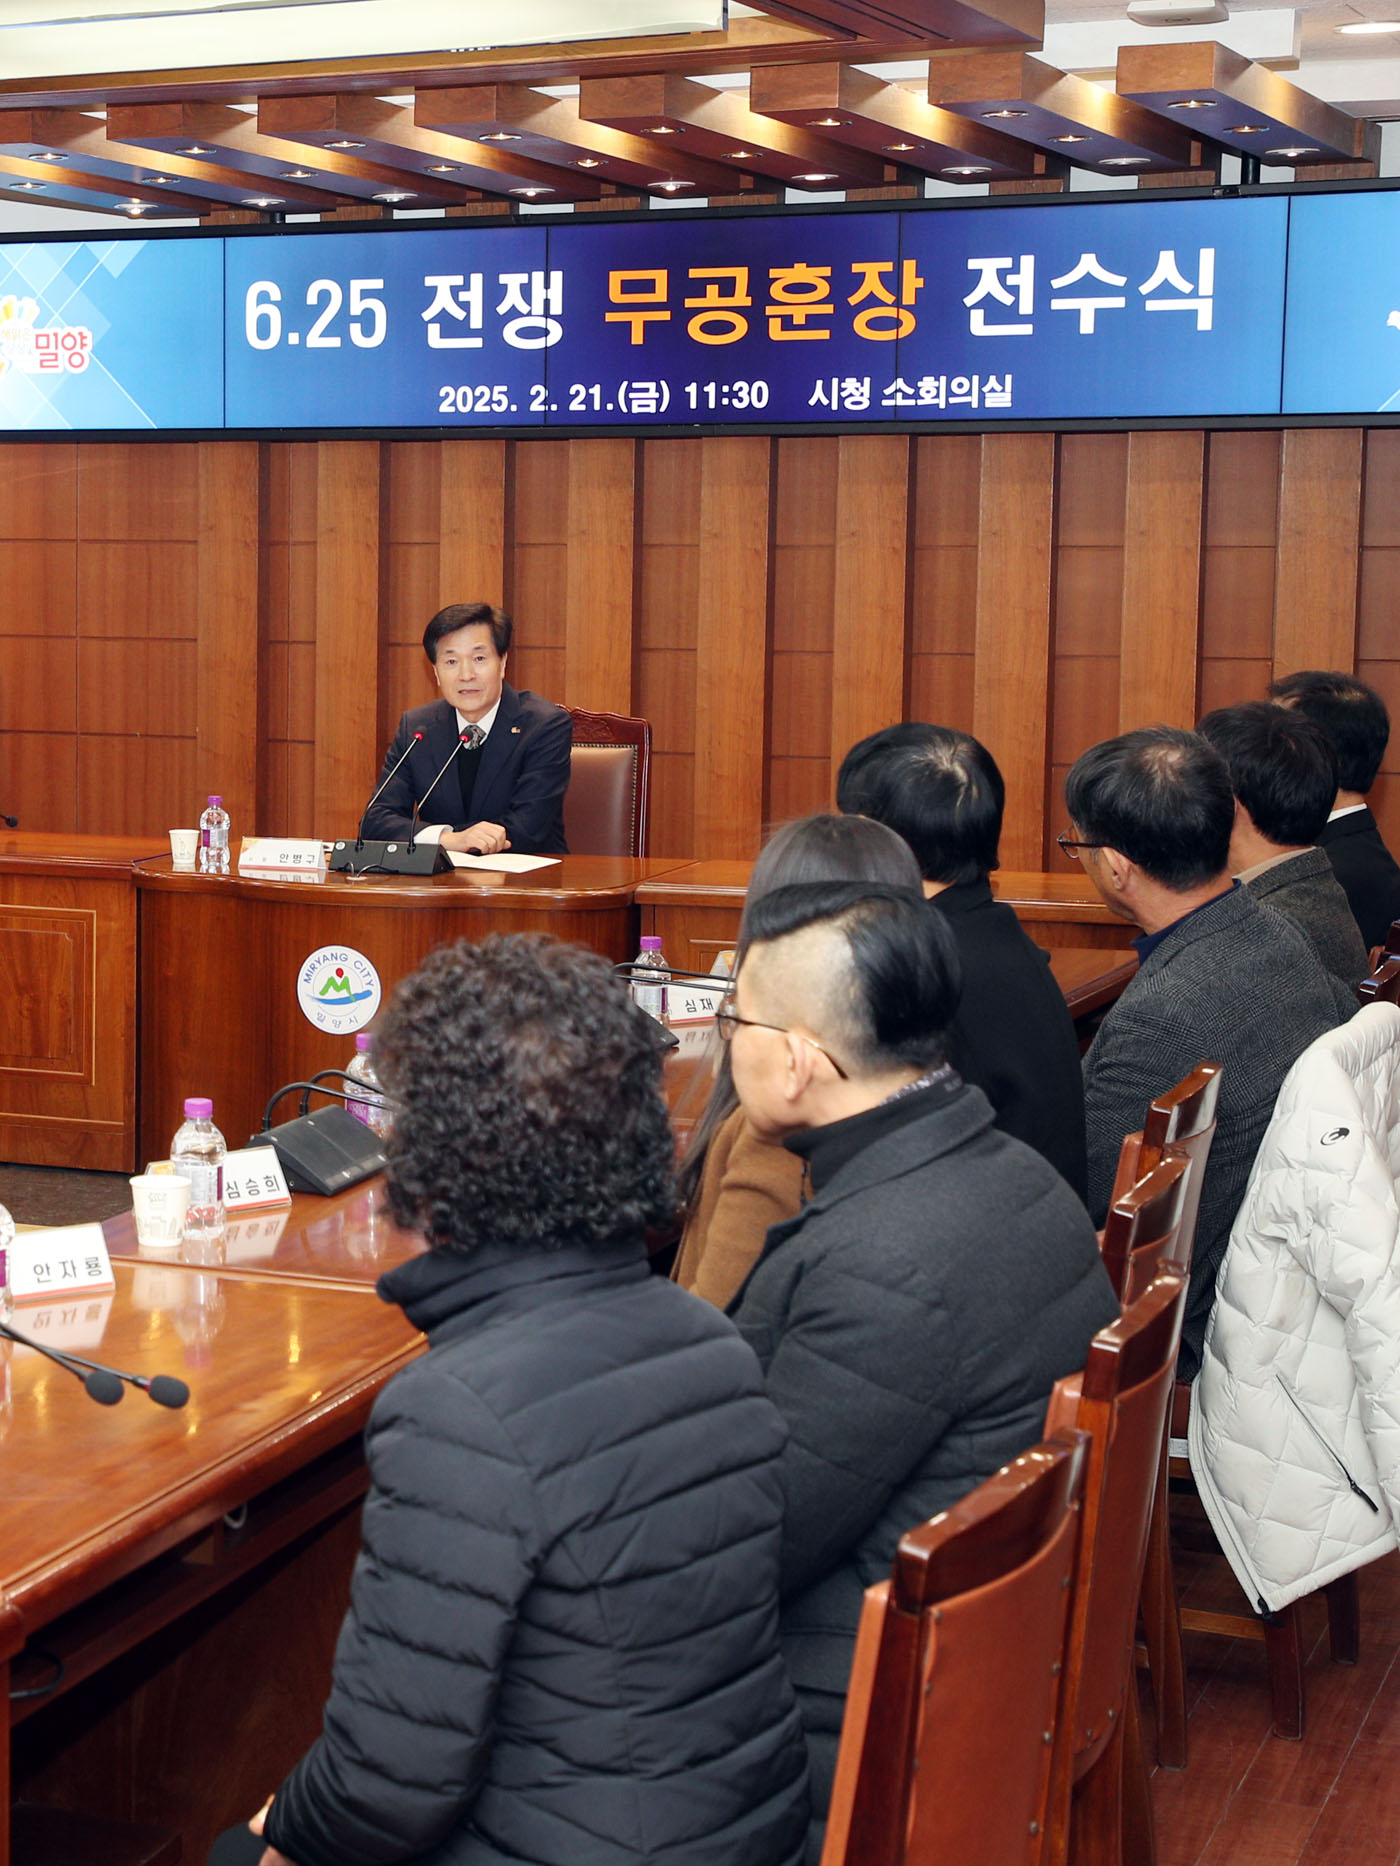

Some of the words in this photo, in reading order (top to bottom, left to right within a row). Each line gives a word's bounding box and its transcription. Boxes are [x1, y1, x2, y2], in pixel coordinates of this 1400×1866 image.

[245, 278, 387, 350] 6.25
[421, 270, 564, 350] 전쟁
[604, 259, 925, 345] 무공훈장
[962, 247, 1215, 337] 전수식
[34, 331, 88, 368] 밀양
[438, 385, 518, 413] 2025.
[529, 384, 558, 412] 2.
[568, 380, 671, 414] 21.(금)
[684, 380, 769, 410] 11:30
[808, 376, 872, 411] 시청
[881, 374, 1013, 410] 소회의실
[303, 952, 349, 984] MIRYANG
[353, 960, 375, 987] CITY
[225, 1174, 281, 1200] 심승희
[33, 1256, 103, 1284] 안자룡
